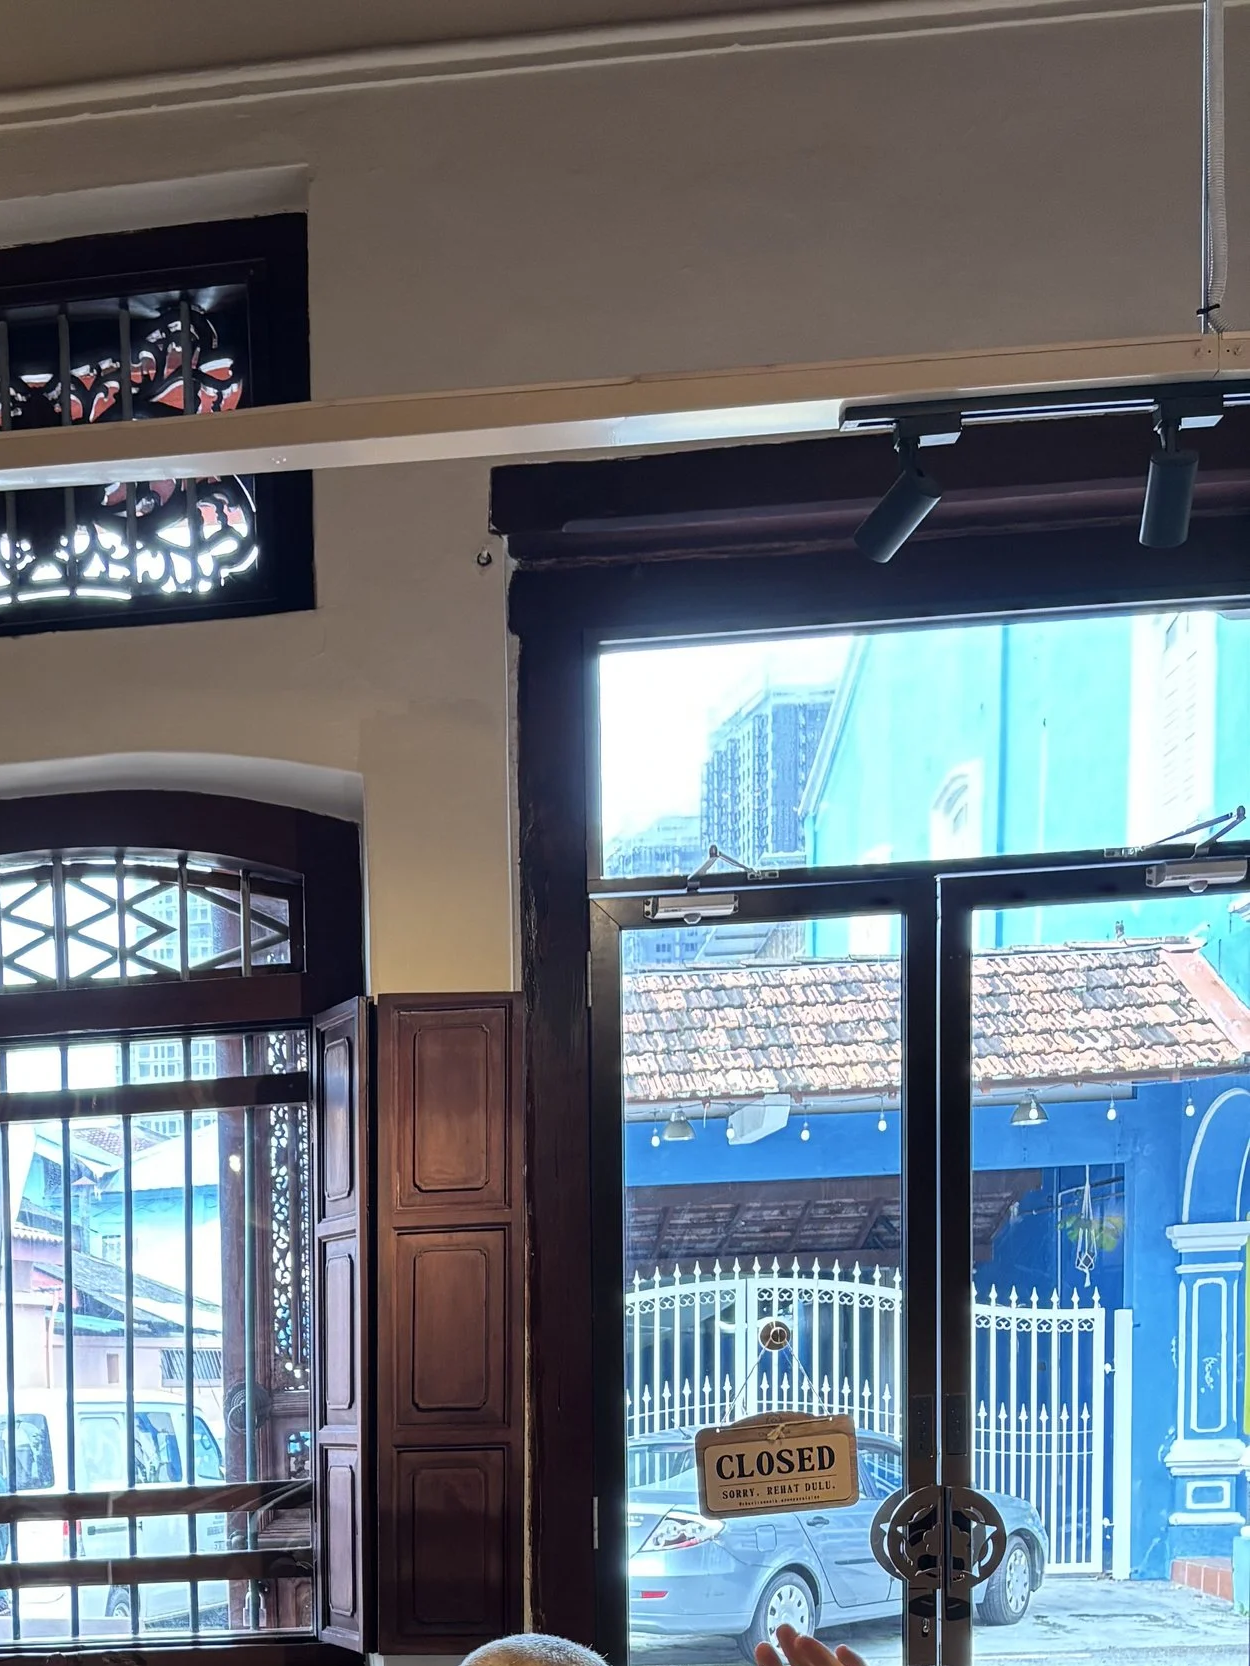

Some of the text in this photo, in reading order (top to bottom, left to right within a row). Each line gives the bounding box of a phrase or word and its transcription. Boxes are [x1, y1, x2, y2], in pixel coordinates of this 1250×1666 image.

[716, 1445, 835, 1480] CLOSED
[722, 1480, 836, 1500] SORRY. REHAT DULU.
